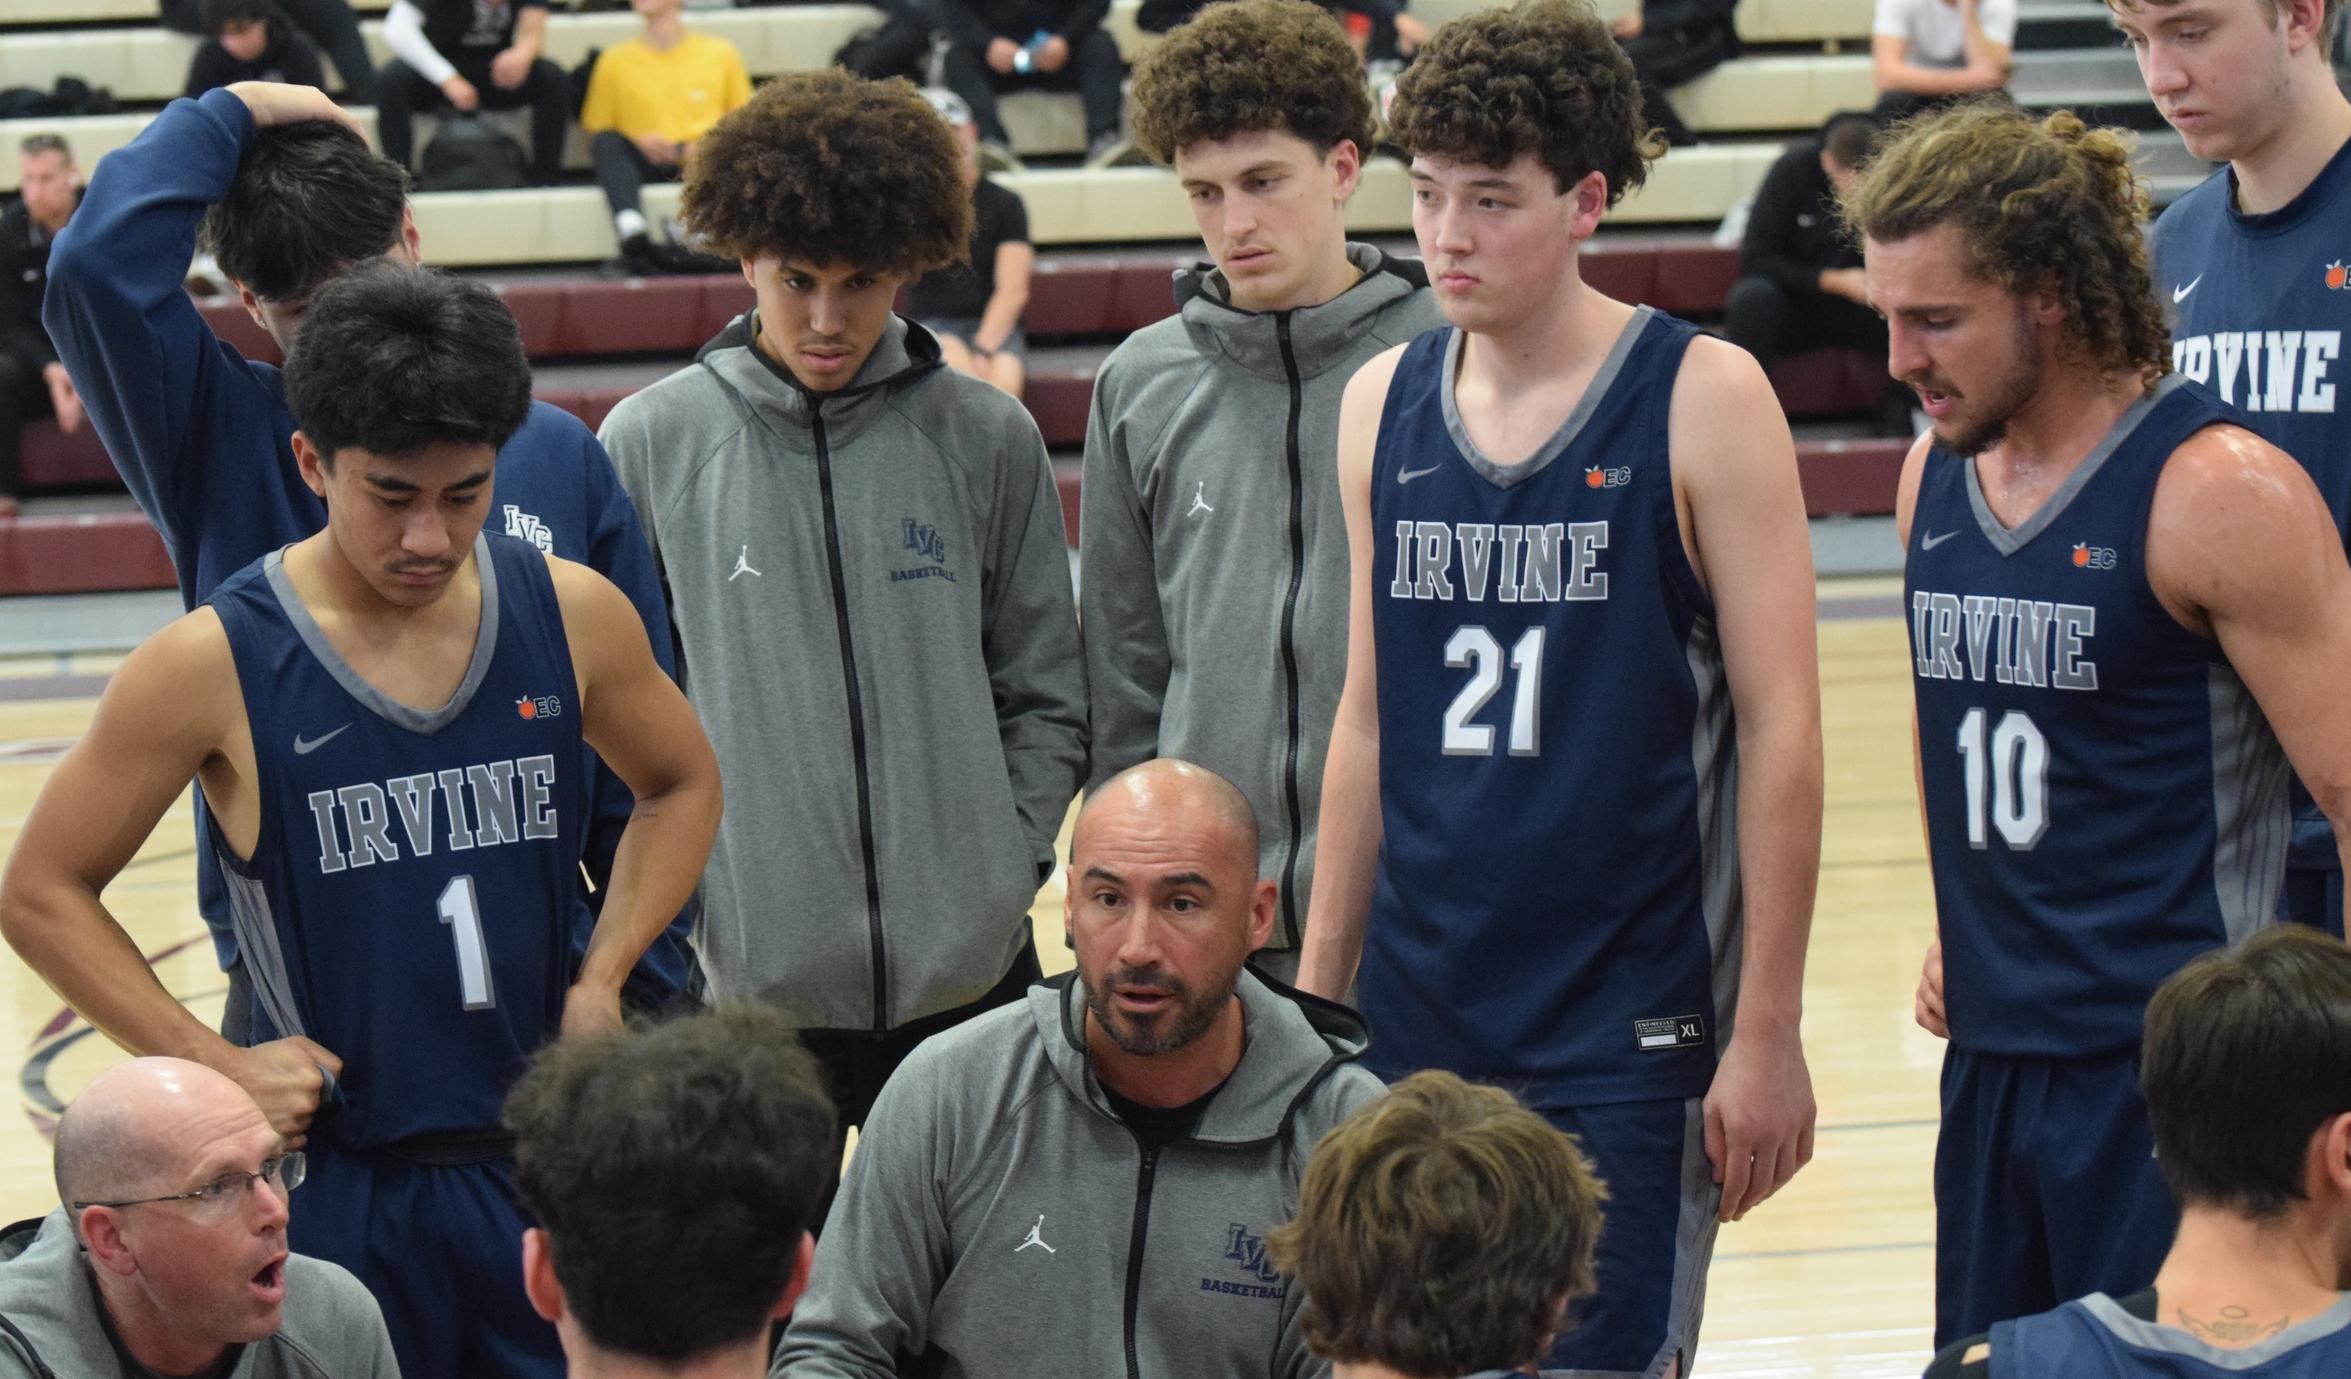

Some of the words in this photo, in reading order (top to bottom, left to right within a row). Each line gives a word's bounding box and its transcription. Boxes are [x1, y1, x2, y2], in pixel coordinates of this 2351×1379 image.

[503, 504, 553, 554] IVC
[901, 517, 945, 564] IVC
[1391, 520, 1608, 602] IRVINE
[1913, 590, 2099, 691] IRVINE
[1441, 624, 1546, 757] 21
[308, 754, 558, 874] IRVINE
[1957, 707, 2050, 851] 10
[436, 874, 496, 1011] 1
[1680, 1023, 1701, 1038] XL
[1200, 1278, 1285, 1298] BASKETBAL
